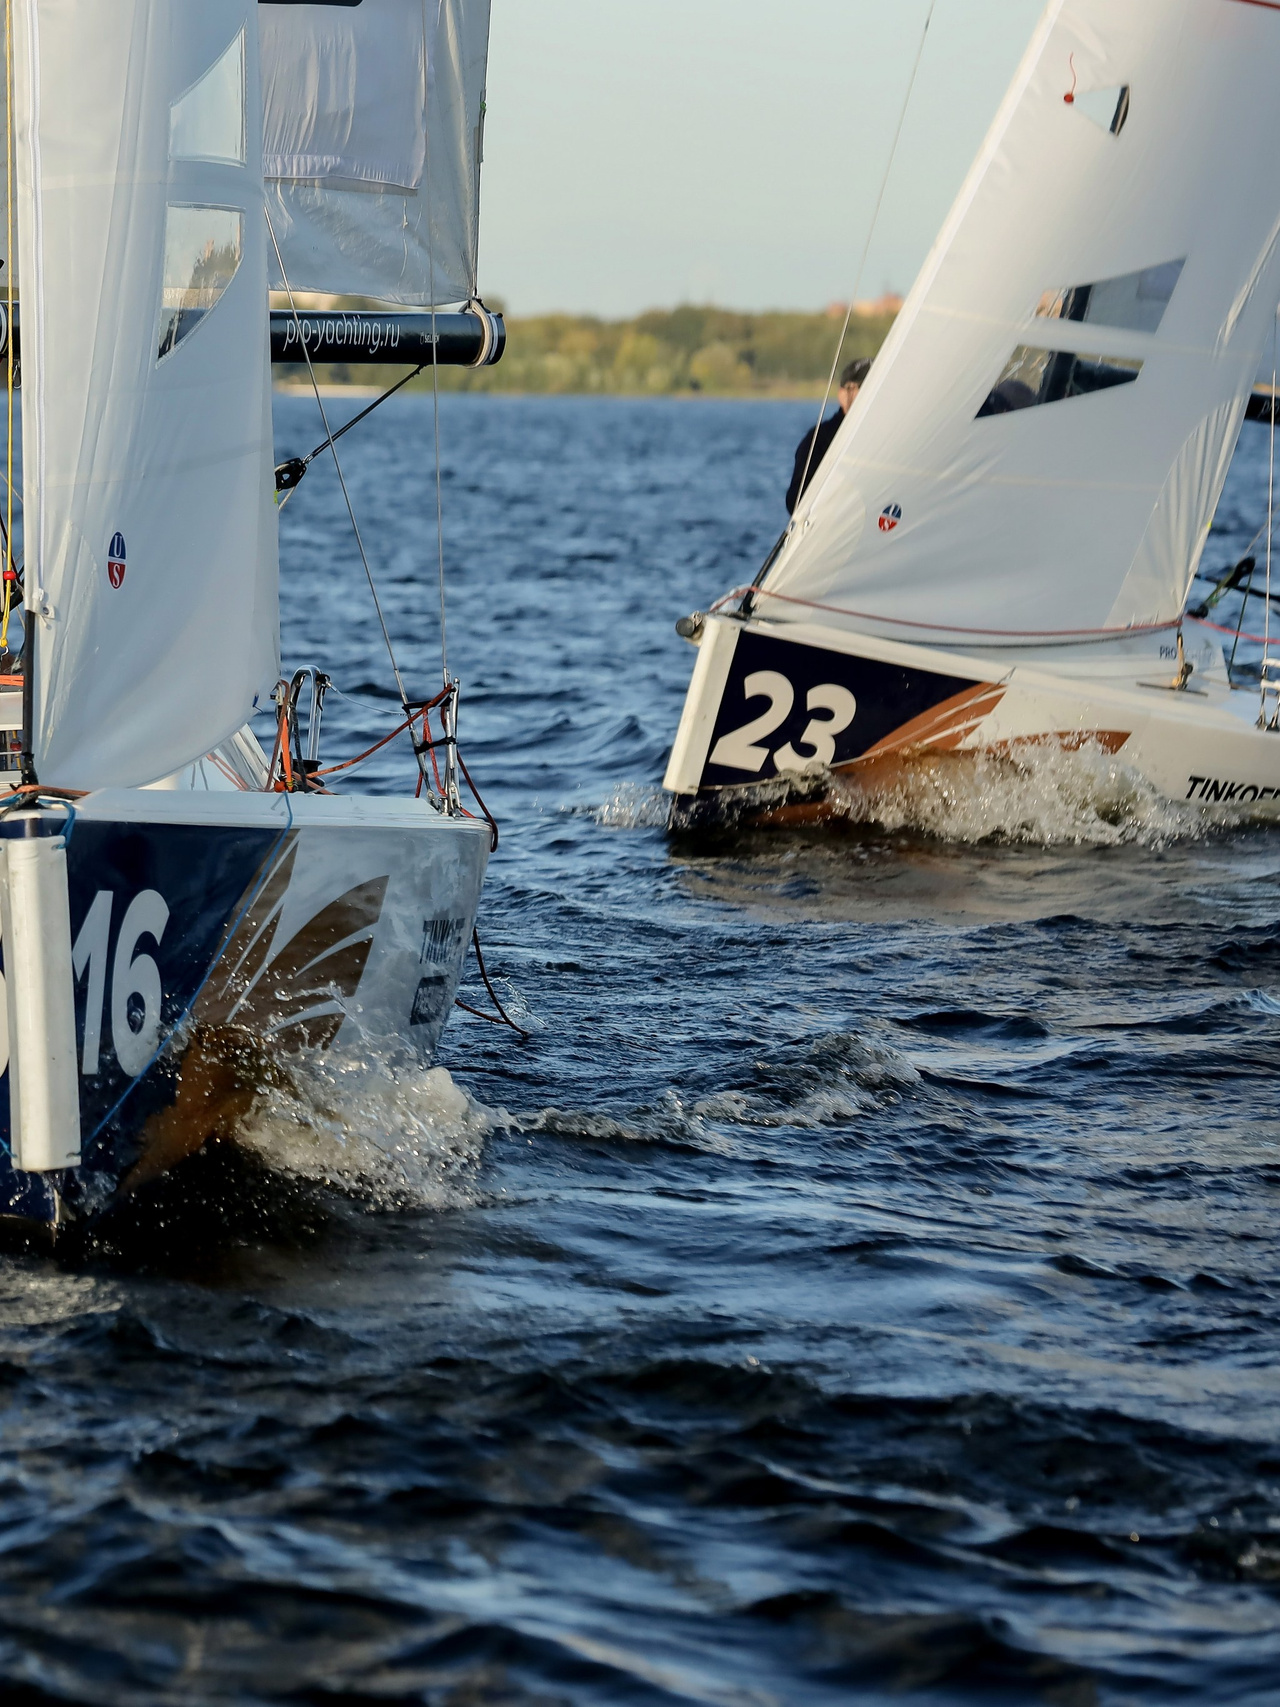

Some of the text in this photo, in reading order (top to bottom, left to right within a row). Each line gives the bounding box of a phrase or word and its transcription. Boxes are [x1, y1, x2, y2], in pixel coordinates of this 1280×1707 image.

[283, 313, 401, 354] pro-yachting.ru
[708, 669, 857, 774] 23
[71, 888, 171, 1078] 16
